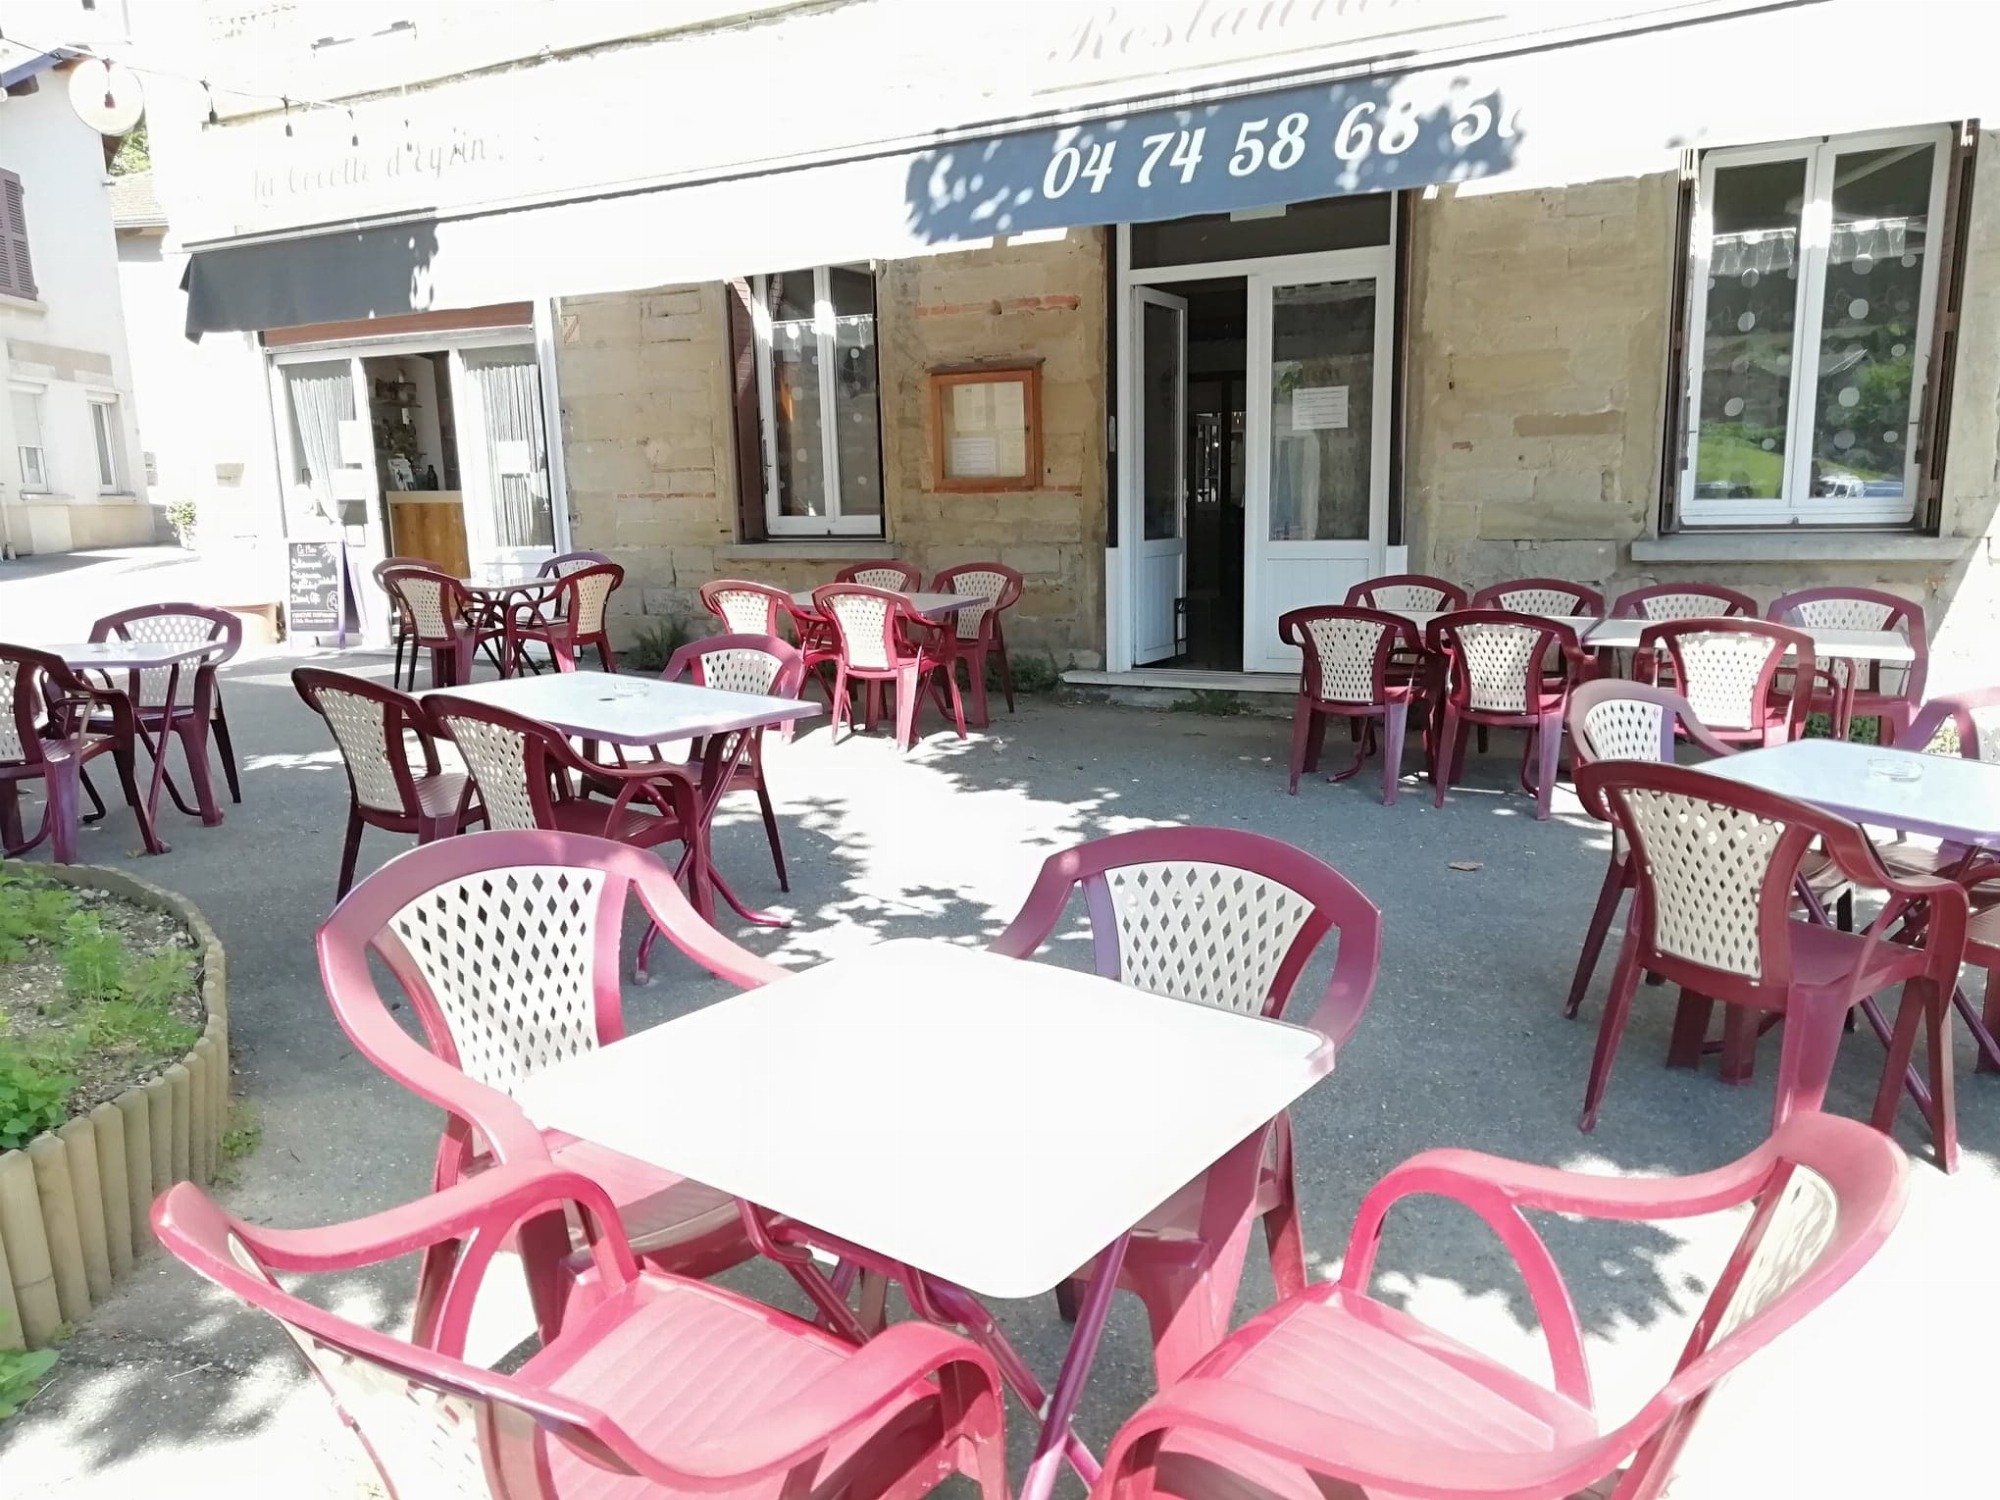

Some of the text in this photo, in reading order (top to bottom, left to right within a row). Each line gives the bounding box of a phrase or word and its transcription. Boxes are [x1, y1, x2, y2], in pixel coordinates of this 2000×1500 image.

[1047, 0, 1421, 62] Restaur
[1043, 140, 1113, 198] 04
[1138, 128, 1205, 187] 74
[1229, 113, 1308, 175] 58
[1335, 97, 1419, 160] 68
